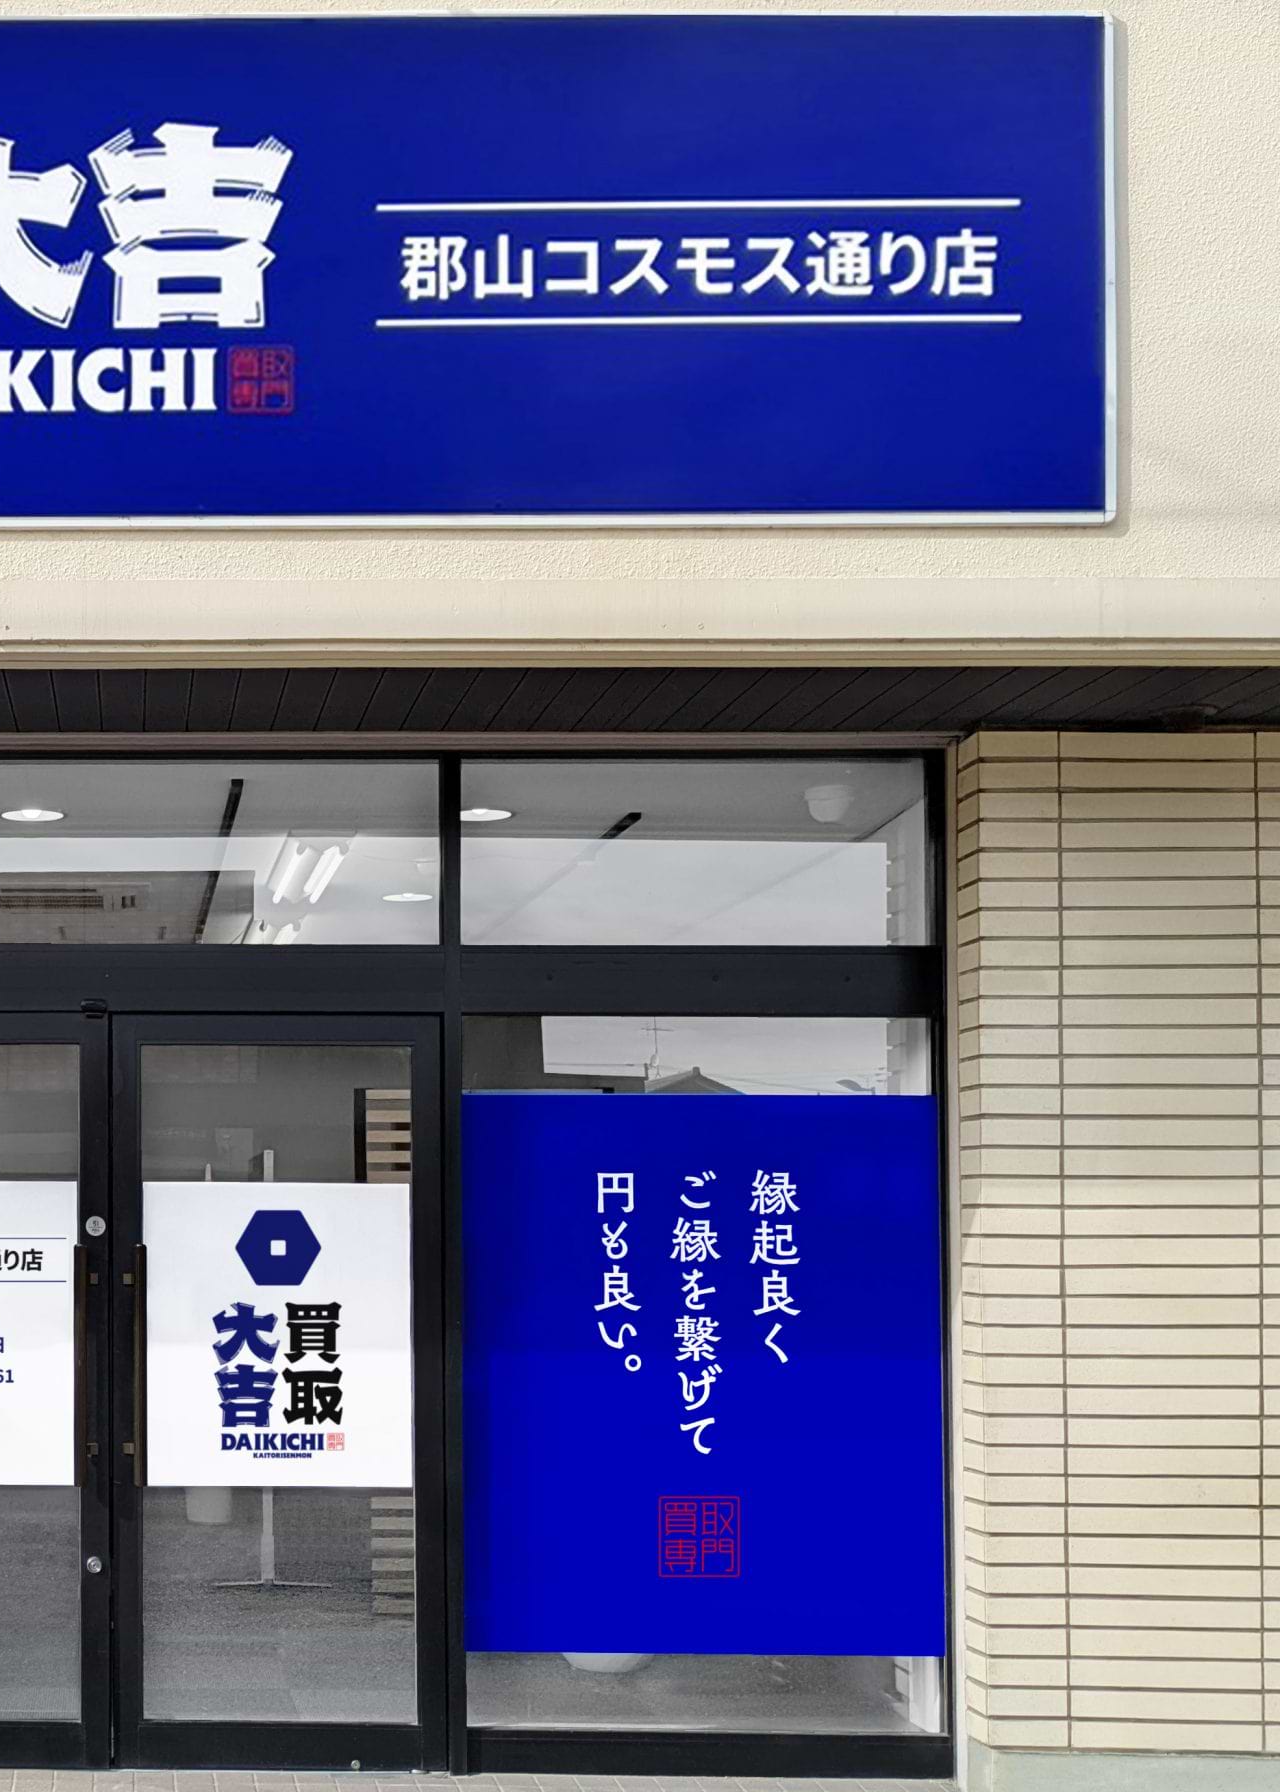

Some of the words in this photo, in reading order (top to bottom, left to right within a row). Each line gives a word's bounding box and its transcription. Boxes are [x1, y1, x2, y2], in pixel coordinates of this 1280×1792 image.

[399, 227, 999, 302] 郡山コスモス通り店
[593, 1172, 642, 1372] 円も良い。
[669, 1170, 724, 1455] ご縁を繋げて
[749, 1169, 801, 1364] 縁起良く
[212, 1301, 281, 1428] 大吉
[282, 1301, 344, 1426] 買取
[220, 1432, 325, 1451] DAIKICHI
